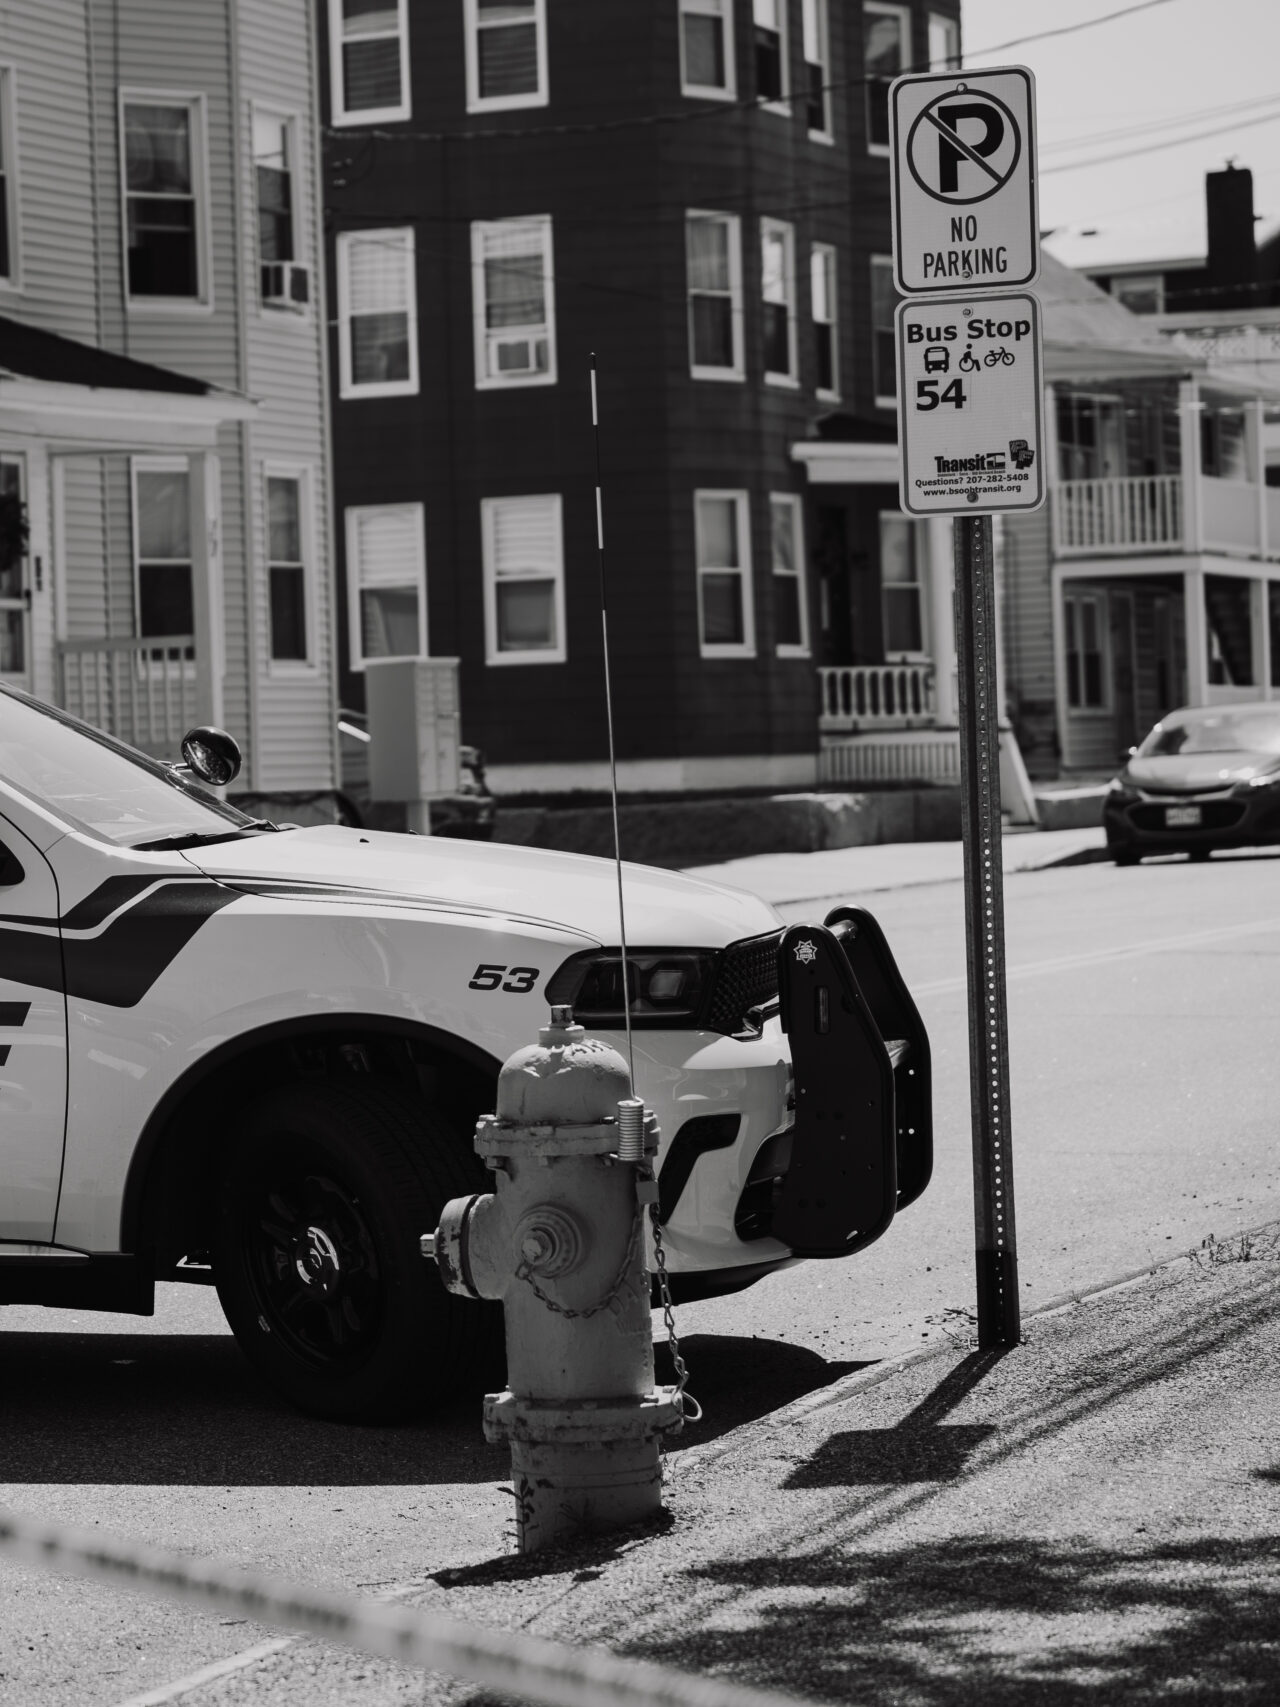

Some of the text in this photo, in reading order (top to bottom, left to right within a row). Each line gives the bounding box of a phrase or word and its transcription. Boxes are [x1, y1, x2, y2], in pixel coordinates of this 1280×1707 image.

[951, 215, 977, 242] NO
[923, 246, 1007, 278] PARKING
[907, 319, 1030, 343] Bus Stop
[916, 378, 967, 411] 54
[915, 477, 963, 488] Questions?
[966, 473, 1029, 484] 207-282-5408
[468, 964, 540, 993] 53
